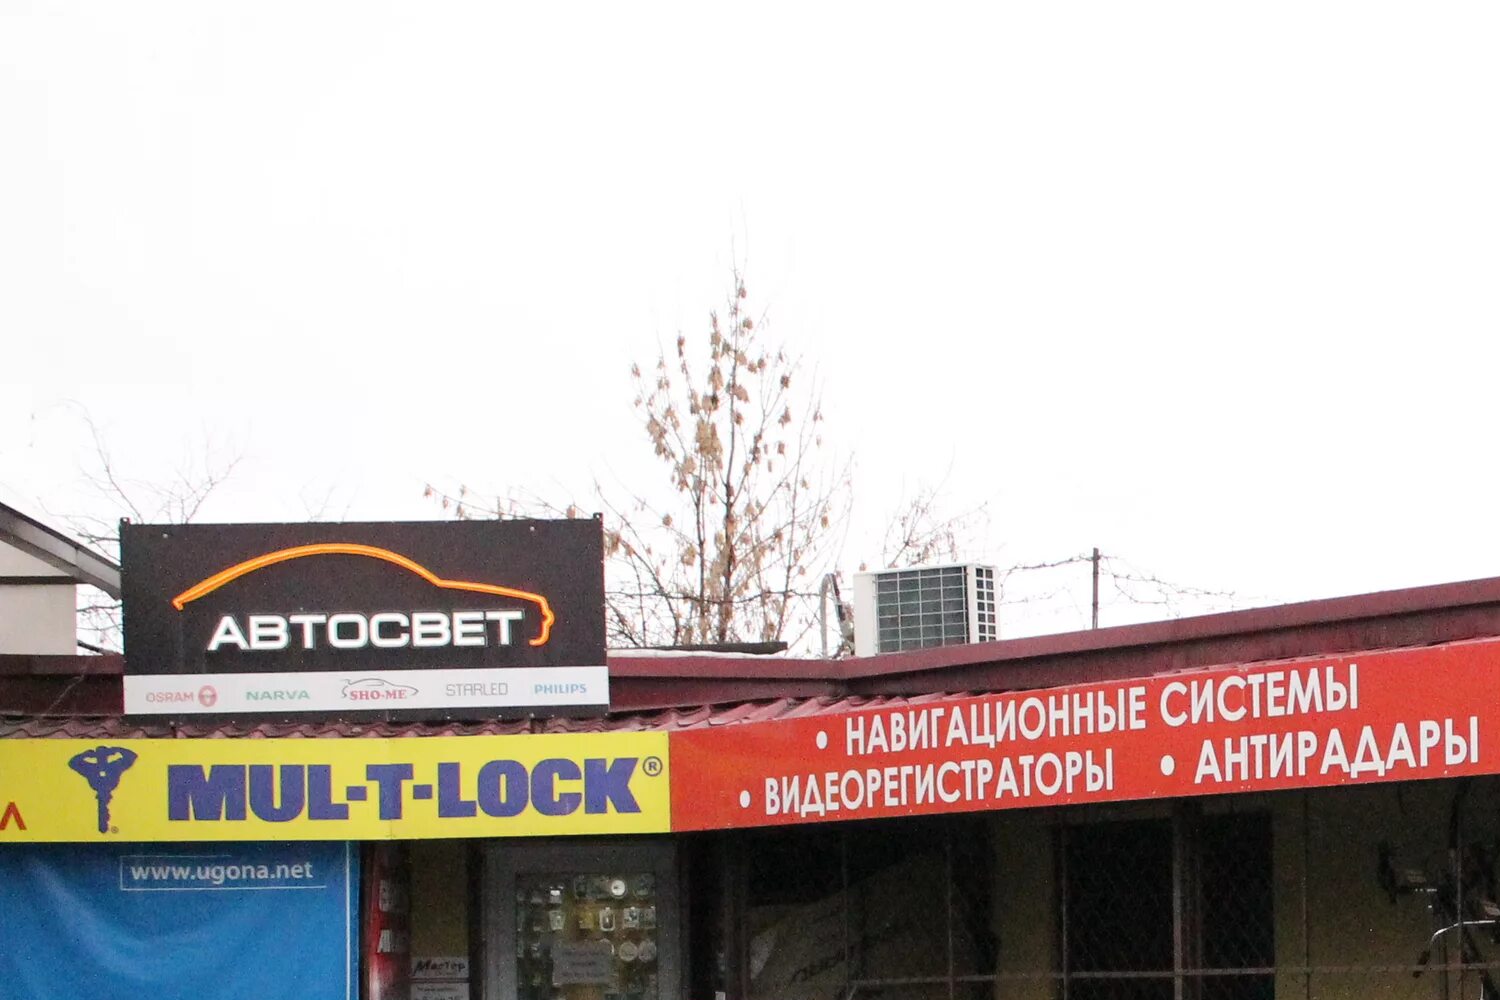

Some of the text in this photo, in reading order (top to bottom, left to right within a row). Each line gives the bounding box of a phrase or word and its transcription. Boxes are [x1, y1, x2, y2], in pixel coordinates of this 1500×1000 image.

[207, 610, 524, 652] АВТОСВЕТ
[145, 690, 194, 704] OSRAM
[246, 690, 310, 702] NARVA
[349, 688, 408, 701] SHO-ME
[446, 682, 508, 697] STARLED
[534, 683, 587, 695] PHILIPS
[845, 663, 1359, 757] НАВИГАЦИОННЫЕ СИСТЕМЫ
[765, 715, 1479, 818] ВИДЕОРЕГИСТРАТОРЫ АНТИРАДАРЫ
[131, 862, 313, 885] www.ugona.net
